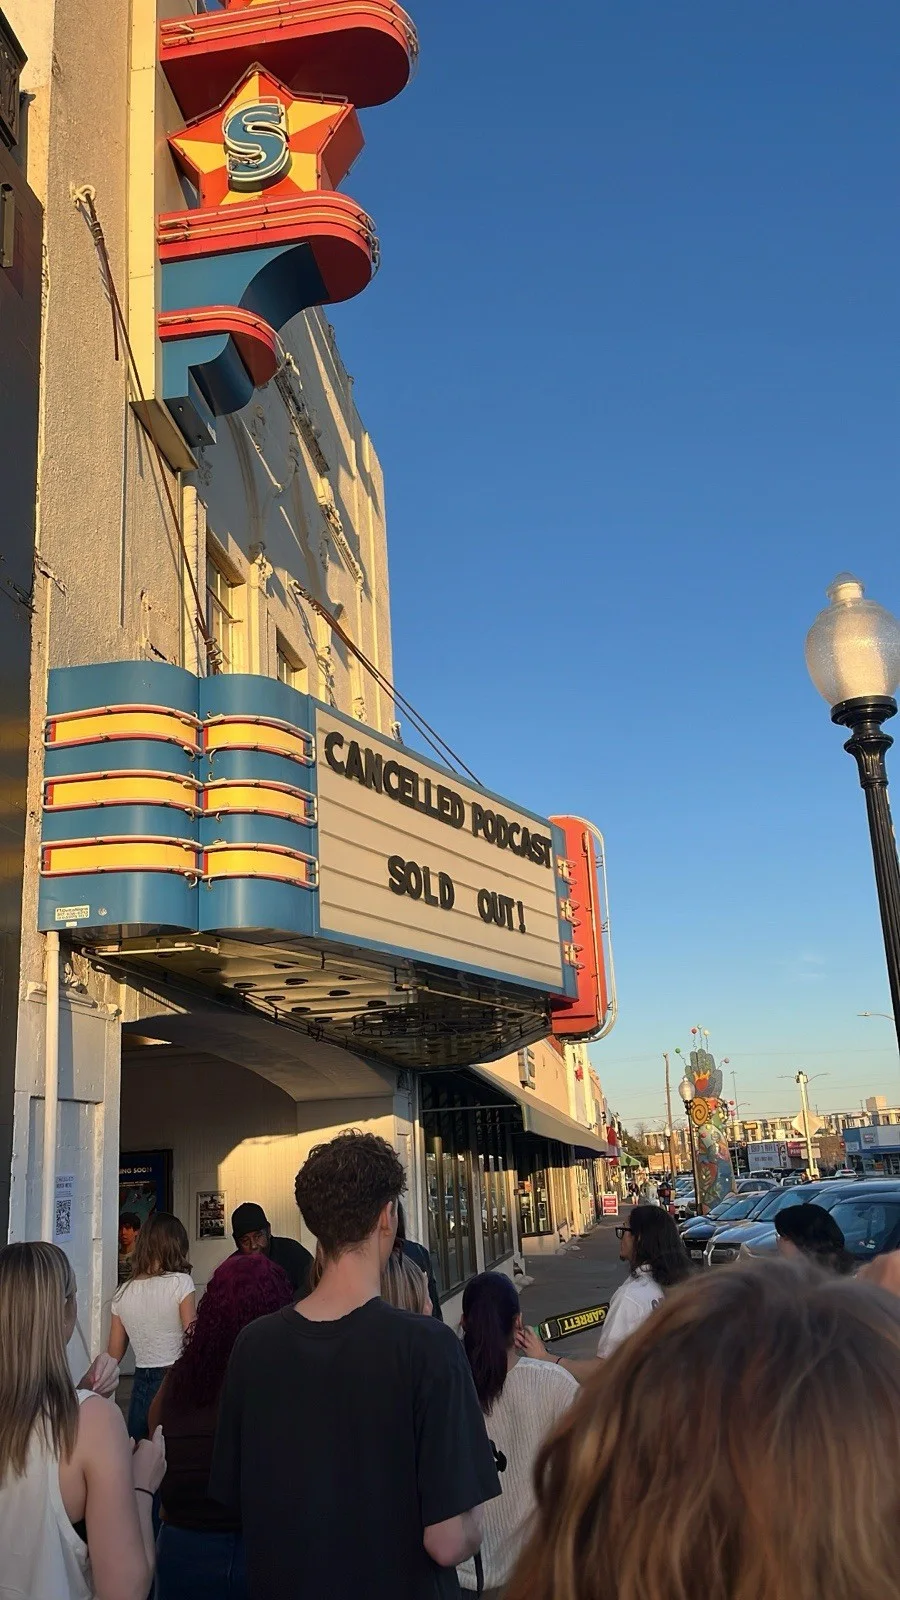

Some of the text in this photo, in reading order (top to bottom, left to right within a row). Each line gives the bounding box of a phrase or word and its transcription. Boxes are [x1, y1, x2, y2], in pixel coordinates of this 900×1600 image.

[222, 96, 290, 188] S
[324, 731, 552, 868] CANCELLED PODCAST
[387, 855, 526, 933] SOLD OUT!
[564, 1309, 606, 1330] GARRETT
